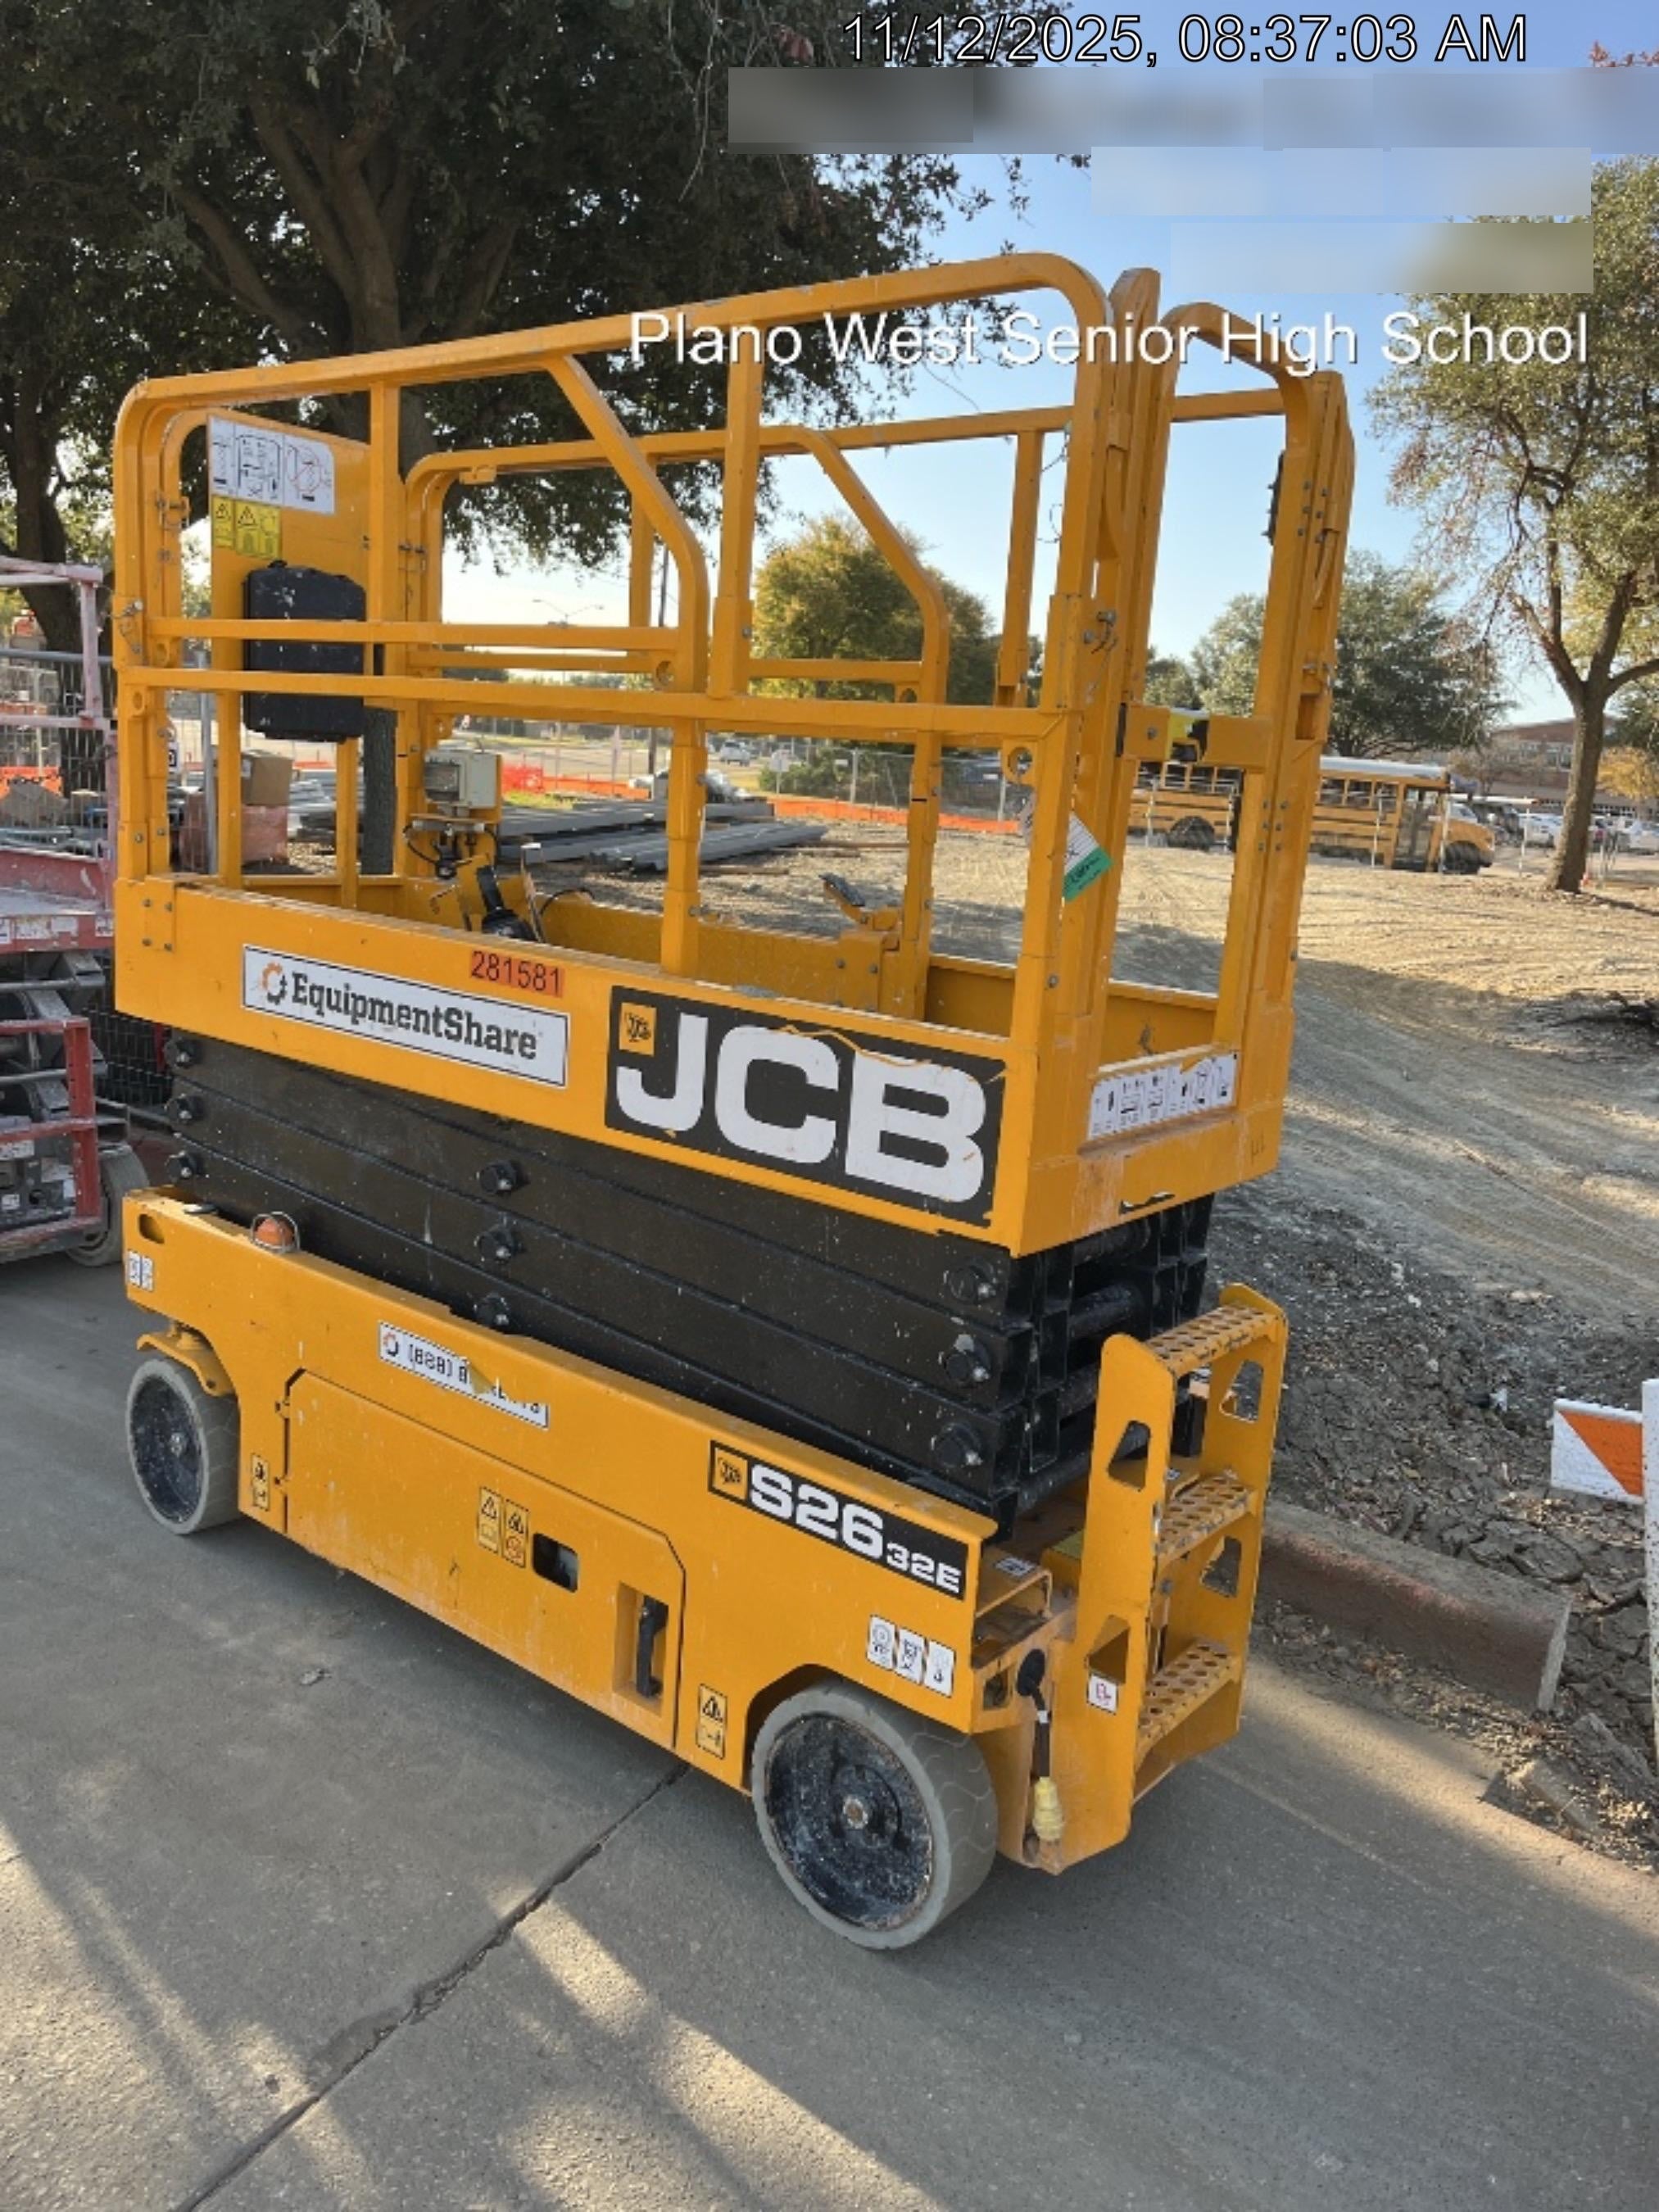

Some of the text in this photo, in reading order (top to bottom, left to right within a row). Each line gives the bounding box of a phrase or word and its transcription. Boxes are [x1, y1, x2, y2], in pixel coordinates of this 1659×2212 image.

[470, 950, 561, 991] 281581
[292, 971, 537, 1060] EquipmentShare
[616, 1012, 986, 1203] JCB
